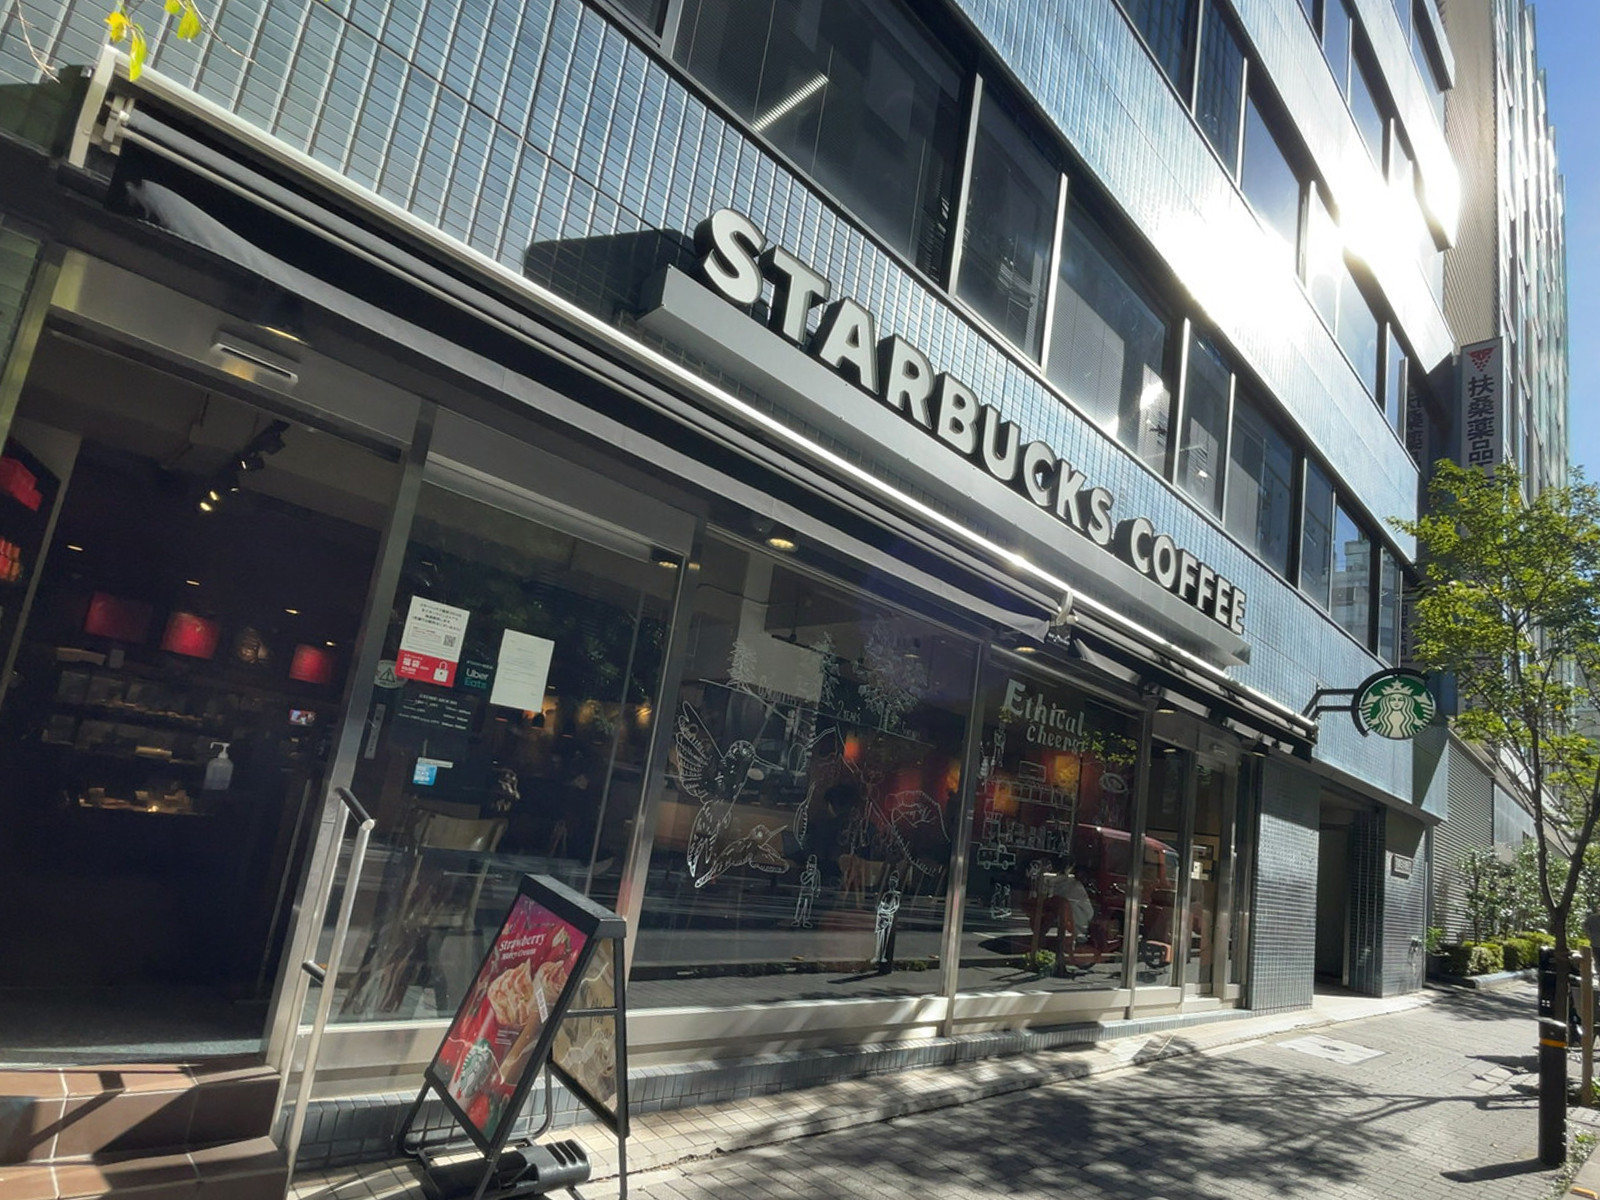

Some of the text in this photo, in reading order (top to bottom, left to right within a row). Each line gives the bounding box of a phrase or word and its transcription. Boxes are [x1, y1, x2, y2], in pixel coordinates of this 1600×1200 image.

[703, 208, 1246, 635] STARBUCKS COFFEE
[464, 677, 487, 689] Eats
[466, 668, 489, 681] Uber
[1002, 678, 1085, 737] Ethical
[500, 934, 547, 951] Strawberry
